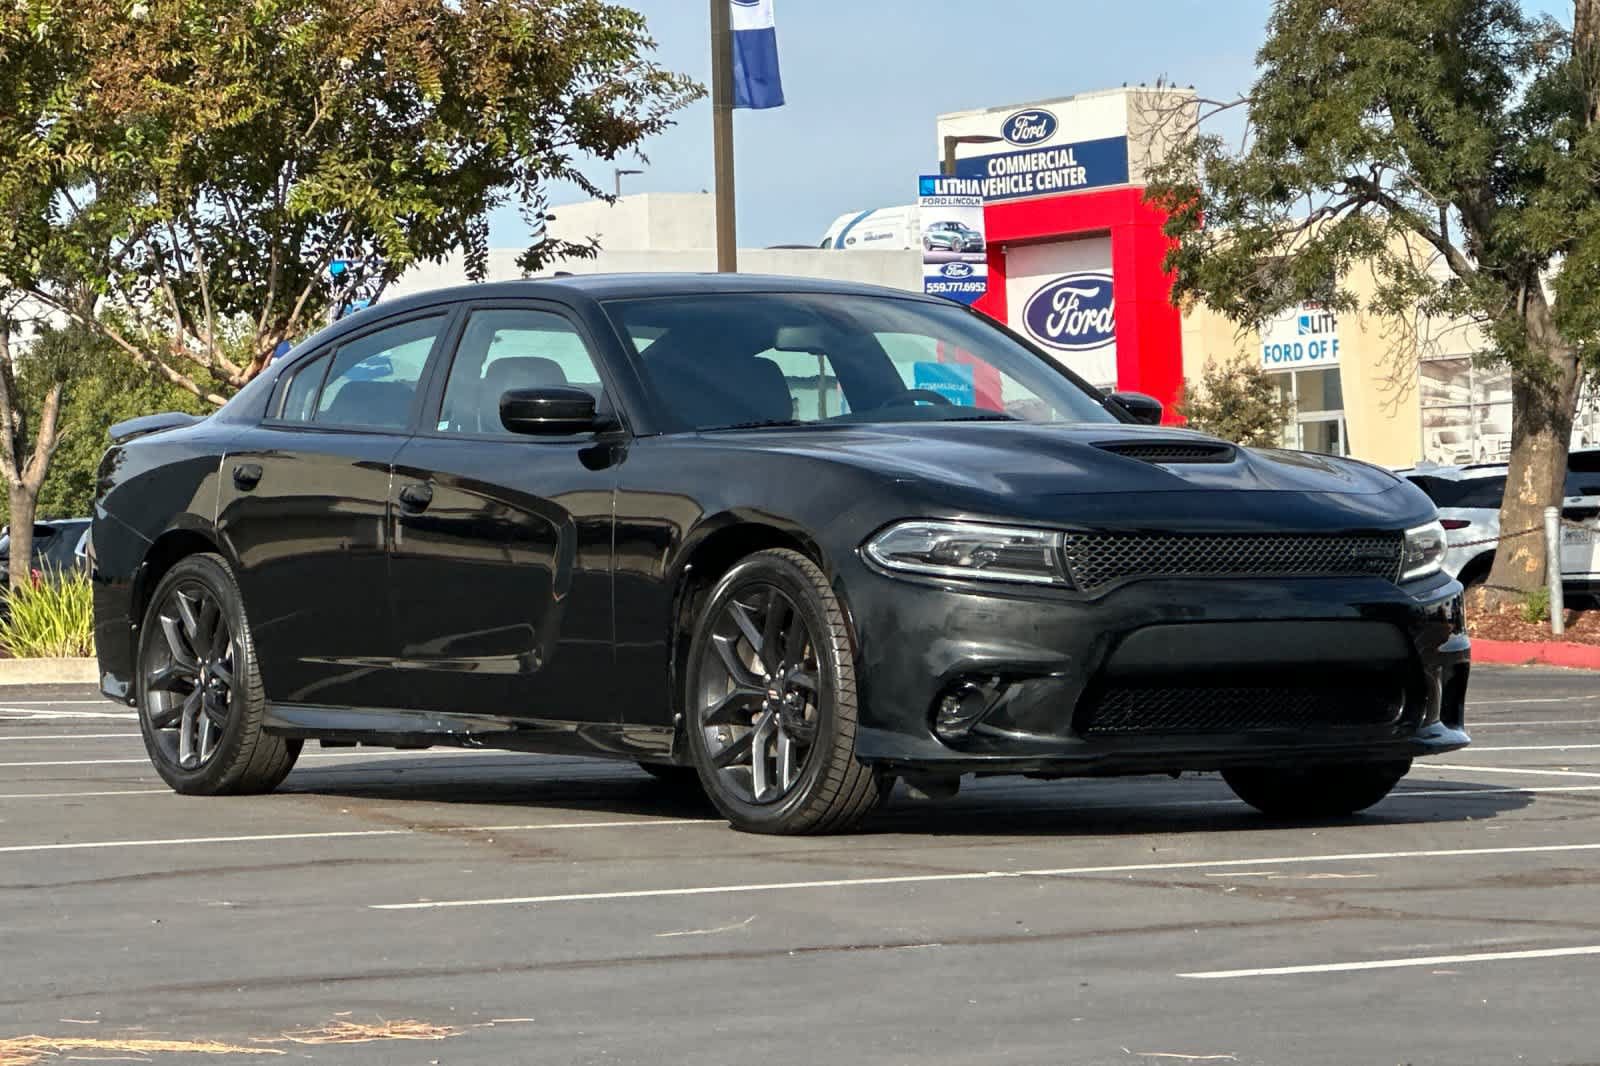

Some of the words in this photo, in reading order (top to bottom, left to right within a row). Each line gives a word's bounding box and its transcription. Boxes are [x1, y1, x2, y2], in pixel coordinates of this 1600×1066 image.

[1011, 114, 1047, 141] Ford
[987, 147, 1078, 177] COMMERCIAL
[934, 178, 981, 195] LITHIA
[981, 173, 1034, 197] VEHICLE
[1035, 166, 1087, 190] CENTER
[922, 197, 947, 205] FORD
[947, 197, 981, 205] LINCOLN
[945, 264, 969, 276] Ford
[1046, 286, 1116, 338] Ford
[1263, 343, 1304, 364] FORD
[1308, 340, 1328, 360] OF
